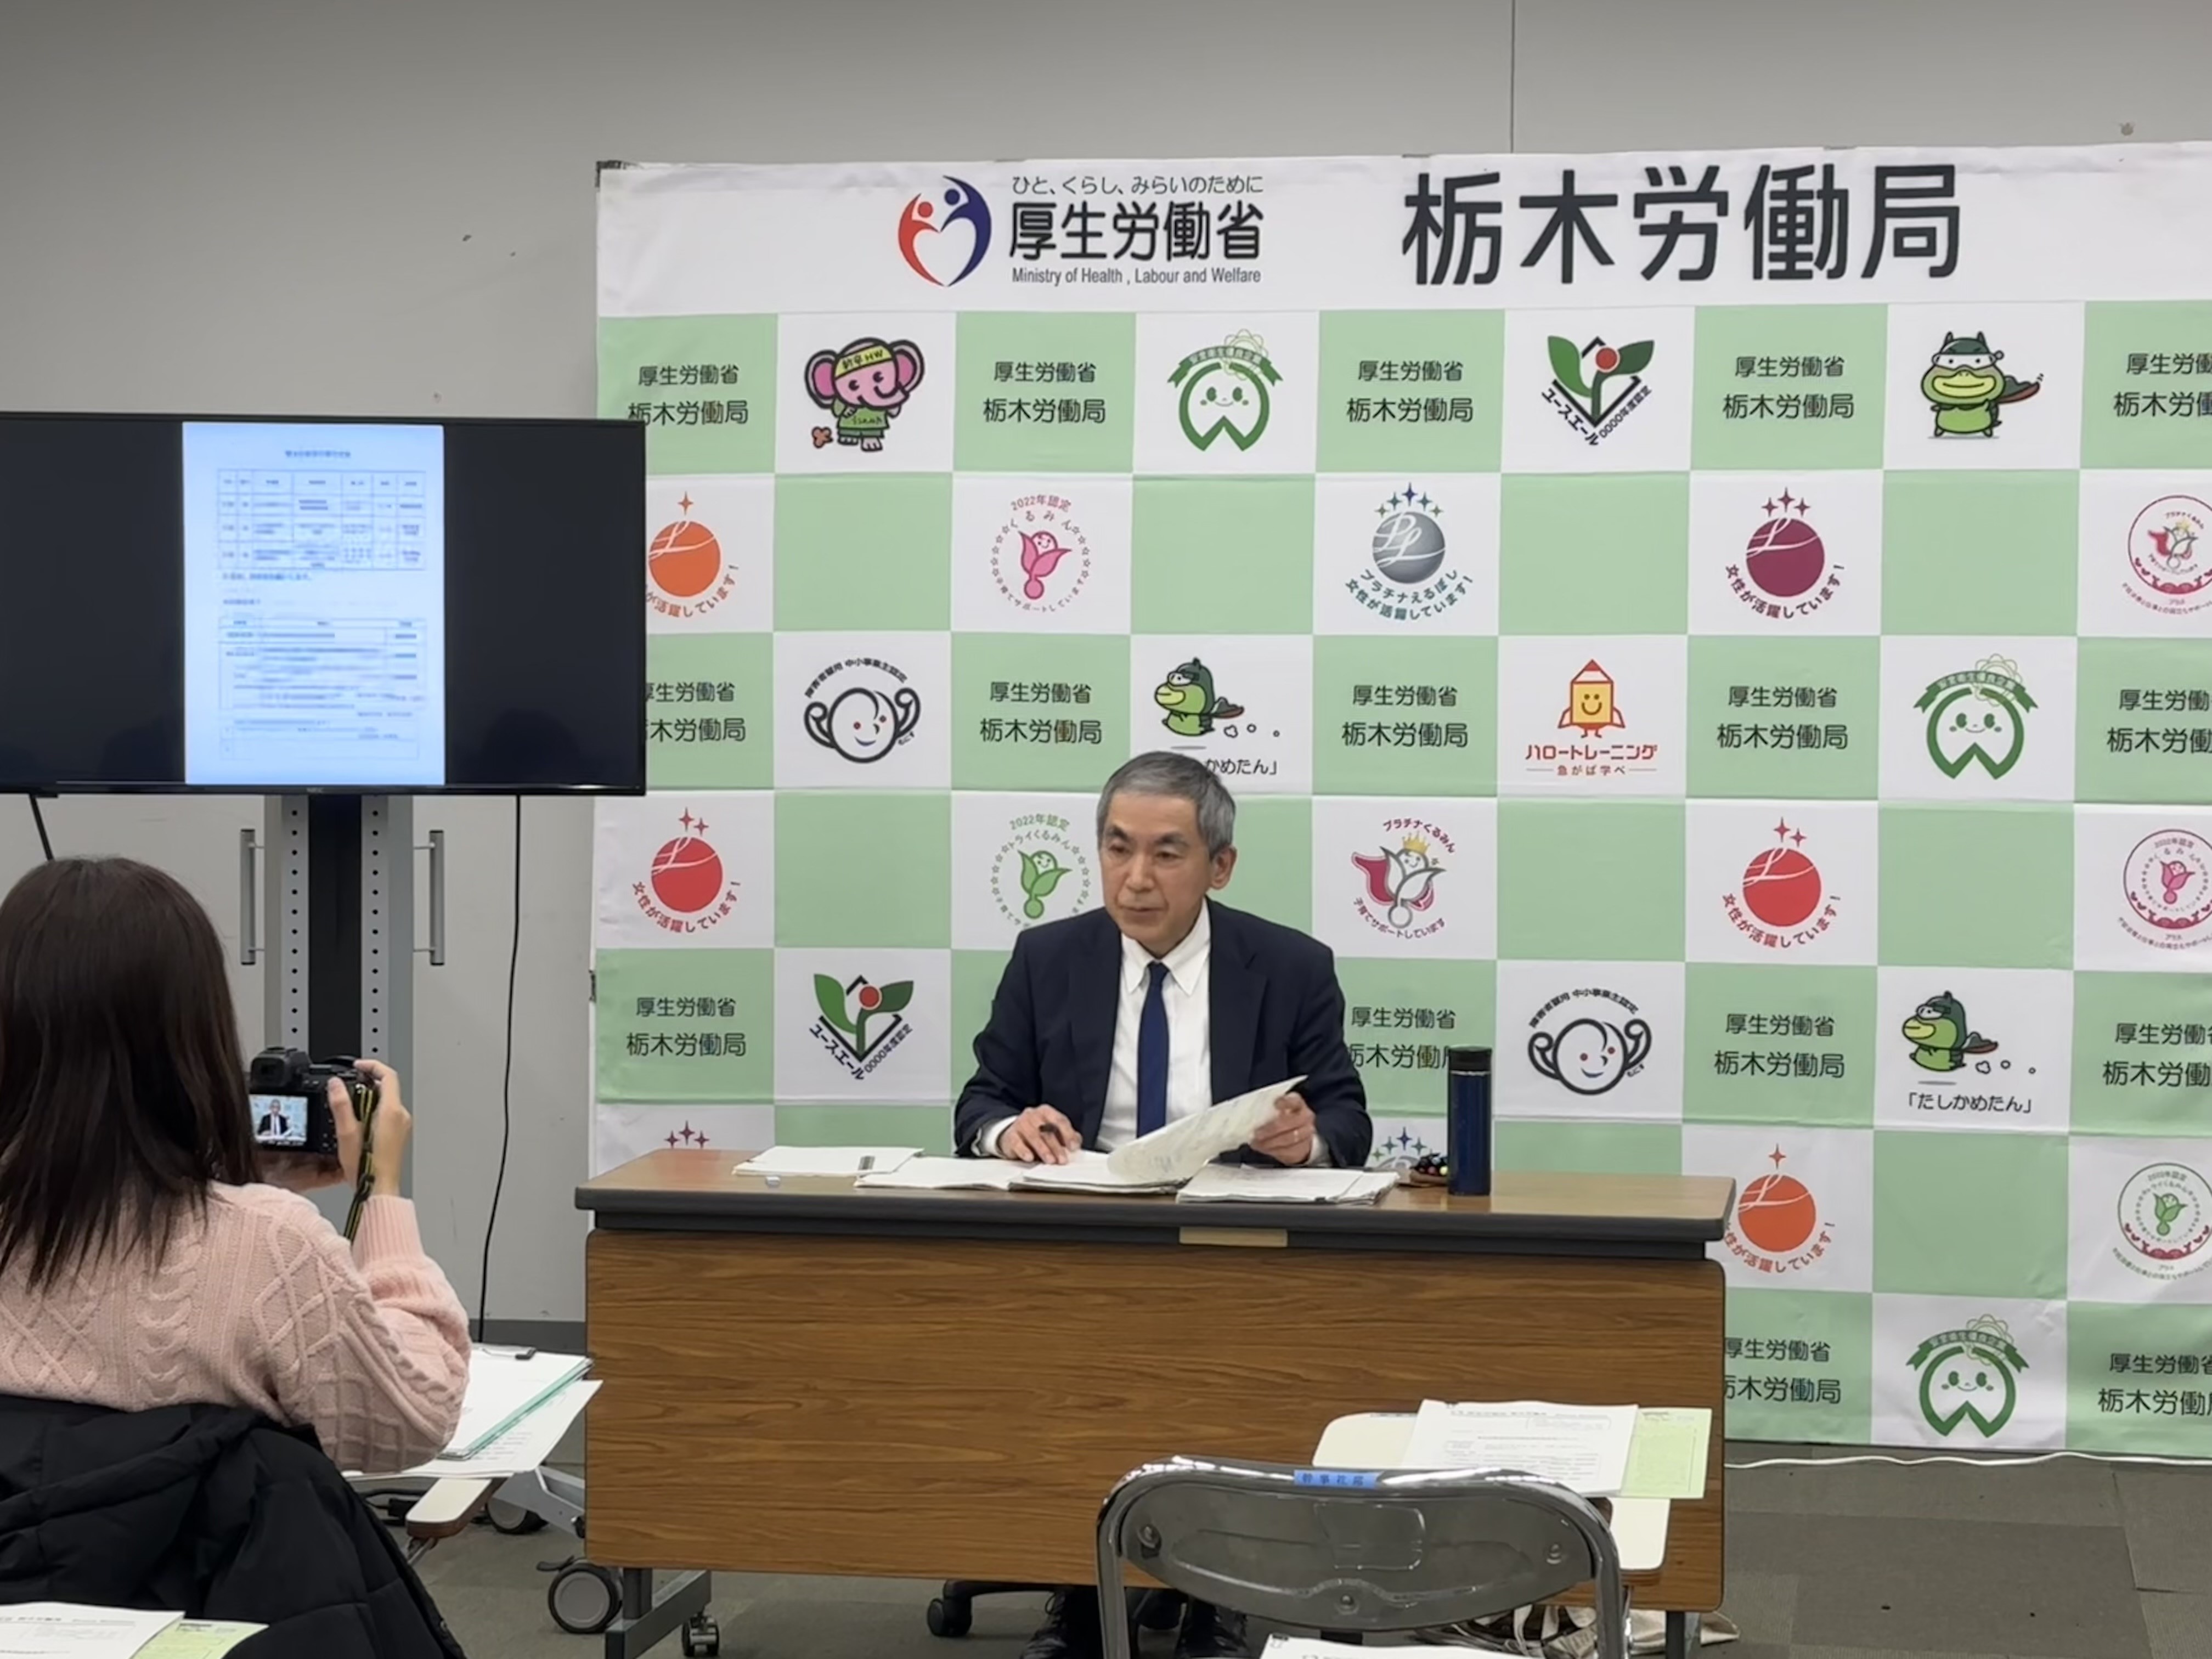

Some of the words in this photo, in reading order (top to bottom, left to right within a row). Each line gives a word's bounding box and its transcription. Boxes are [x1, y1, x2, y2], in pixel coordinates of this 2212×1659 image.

[1012, 174, 1263, 195] ひと、くらし、みらいのために
[1009, 199, 1264, 262] 厚生労働省
[1402, 163, 1960, 286] 栃木労働局
[1012, 267, 1062, 287] Ministry
[1065, 267, 1079, 284] of
[1135, 267, 1180, 284] Labour
[1183, 267, 1207, 284] and
[1211, 267, 1261, 284] Welfare
[638, 364, 740, 387] 厚生労働省
[994, 361, 1097, 383] 厚生労働省
[1358, 360, 1464, 382] 厚生労働省
[1735, 355, 1845, 378] 厚生労働省
[628, 399, 749, 426] 栃木労働局
[983, 397, 1106, 424] 栃木労働局
[1346, 397, 1474, 423] 栃木労働局
[1542, 388, 1599, 445] ユースエール
[1722, 393, 1854, 420] 栃木労働局
[1011, 494, 1071, 512] 2022年認定
[1361, 569, 1457, 604] プラチナえるぼし
[990, 681, 1092, 704] 厚生労働省
[1352, 684, 1458, 707] 厚生労働省
[1728, 685, 1838, 708] 厚生労働省
[646, 715, 746, 746] 木労働局
[979, 718, 1102, 745] 栃木労働局
[1341, 721, 1468, 748] 栃木労働局
[1717, 723, 1848, 750] 栃木労働局
[2106, 726, 2212, 754] 栃木労働
[1525, 744, 1658, 760] ハロートレーニング
[1557, 764, 1626, 776] 急がば学べ
[1009, 814, 1070, 831] 2022年認定
[1383, 818, 1455, 854] プラチナくるみん
[636, 996, 736, 1018] 厚生労働省
[1351, 1006, 1457, 1030] 厚生労働省
[1725, 1013, 1835, 1037] 厚生労働省
[2114, 1022, 2212, 1046] 厚生労働
[626, 1032, 747, 1057] 栃木労働局
[809, 1024, 865, 1080] ユースエール
[1714, 1049, 1845, 1079] 栃木労働局
[1909, 1092, 2032, 1114] 「たしかめたん」
[2097, 1387, 2212, 1417] 栃木労働
